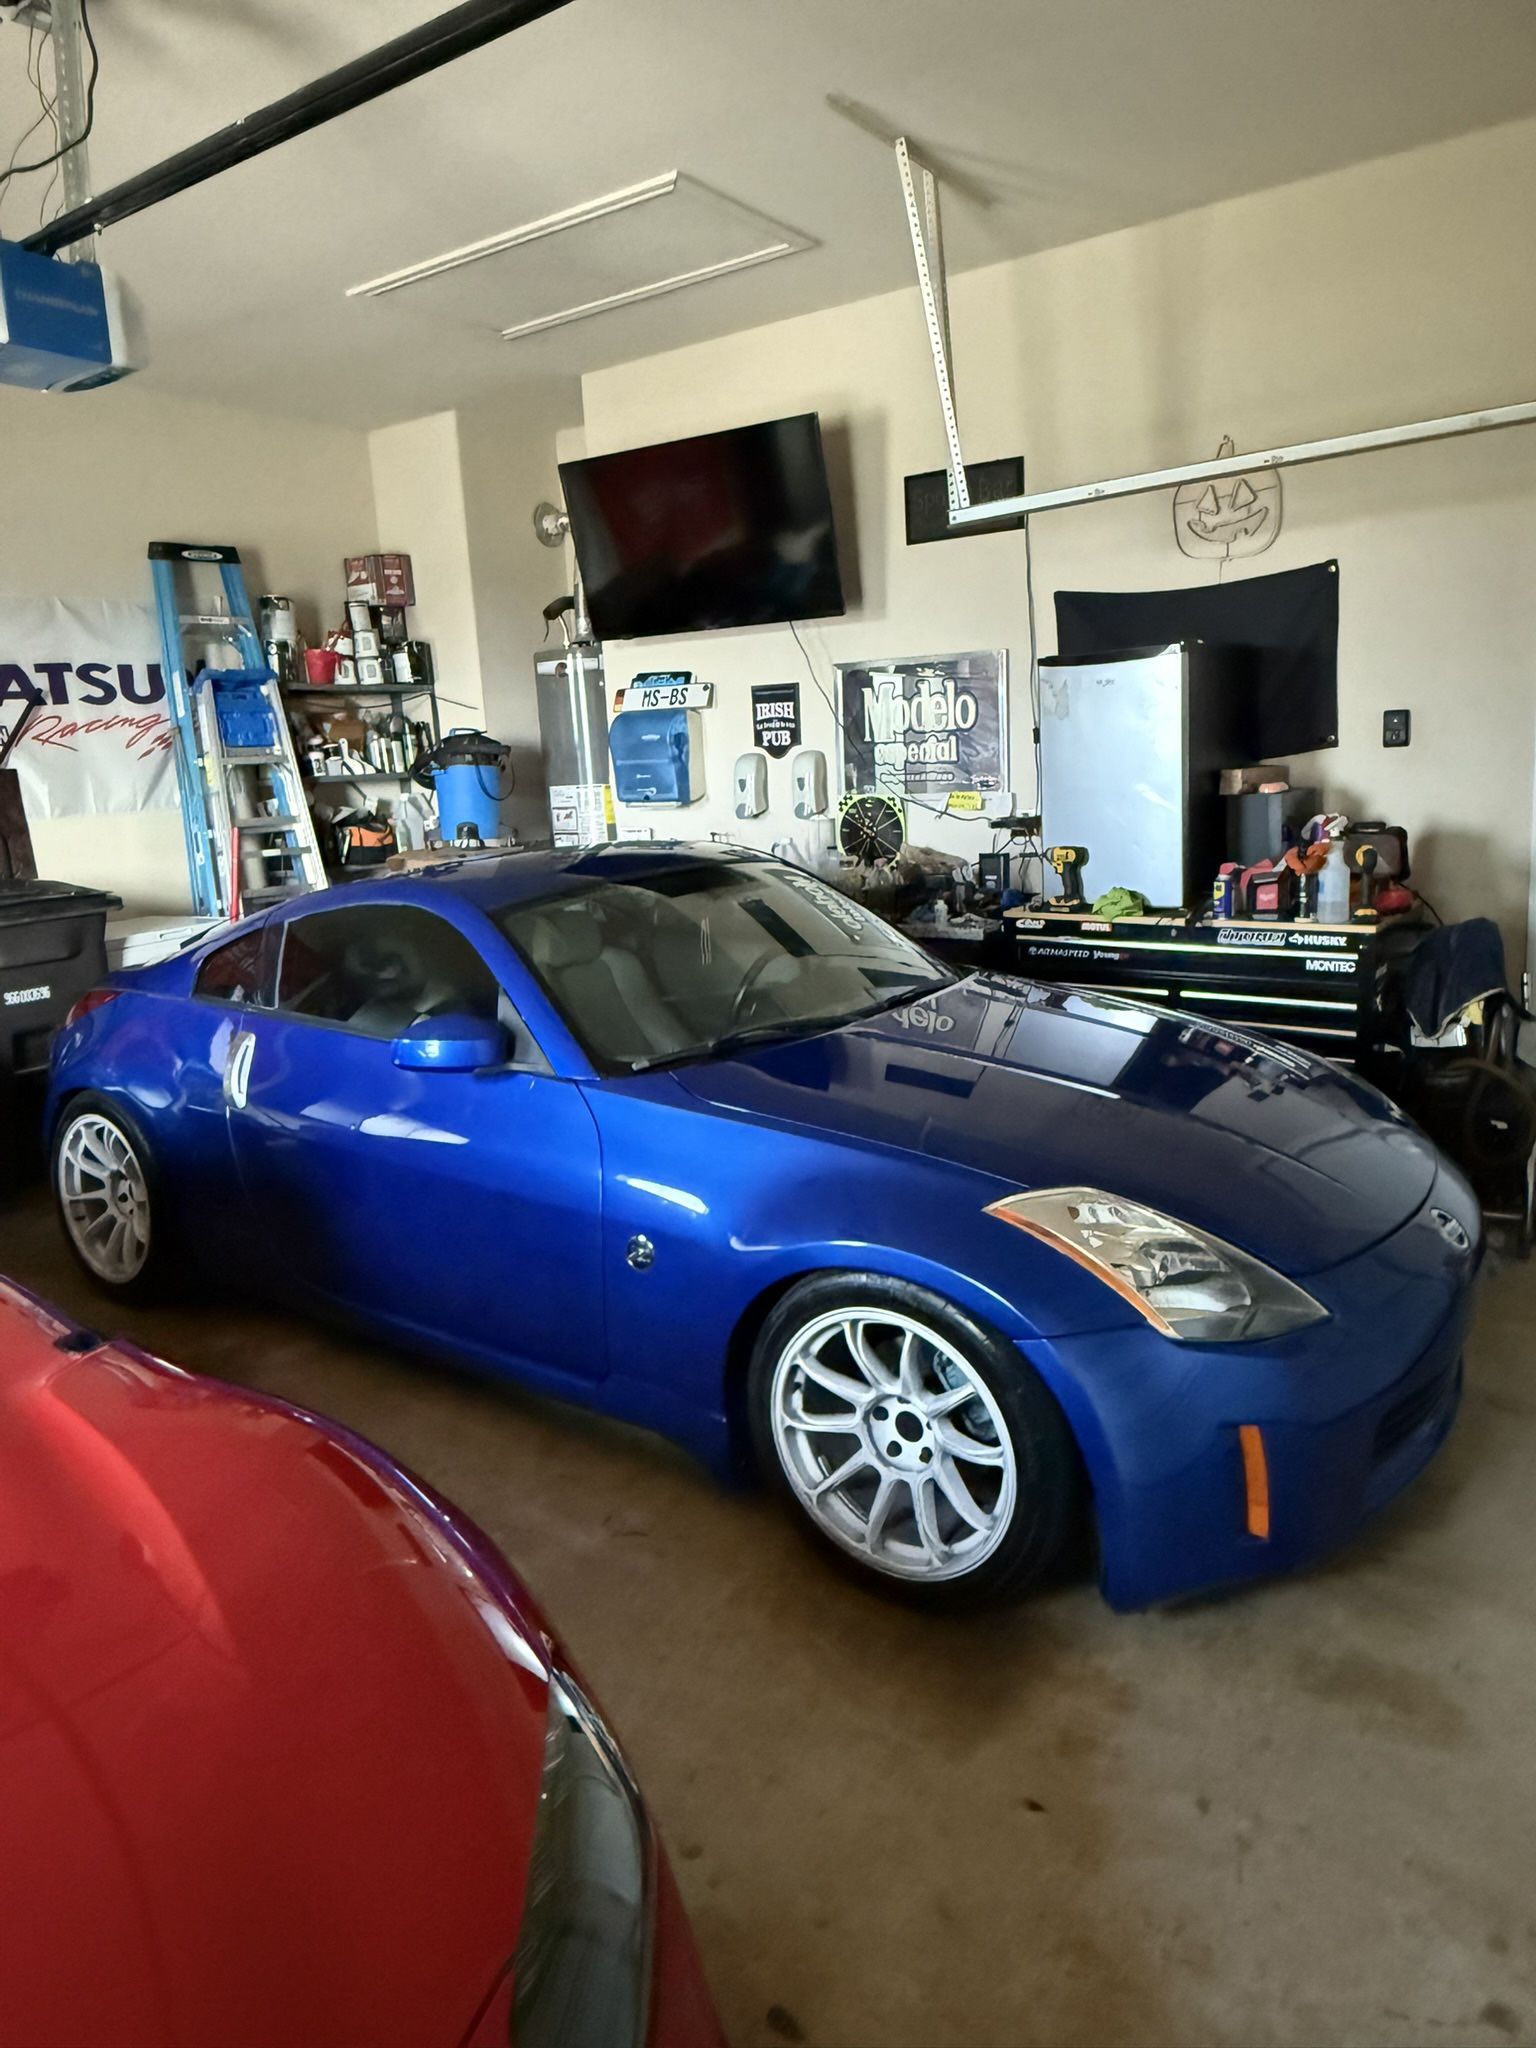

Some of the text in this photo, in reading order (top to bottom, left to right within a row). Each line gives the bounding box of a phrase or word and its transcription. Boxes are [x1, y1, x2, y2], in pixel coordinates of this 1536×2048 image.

[642, 687, 688, 708] MS-BS
[755, 701, 795, 721] IRISH
[861, 678, 979, 743] Modelo
[14, 712, 172, 752] Racing
[762, 730, 791, 746] PUB
[1304, 934, 1347, 947] HUSKY
[1305, 959, 1357, 973] MONTEC
